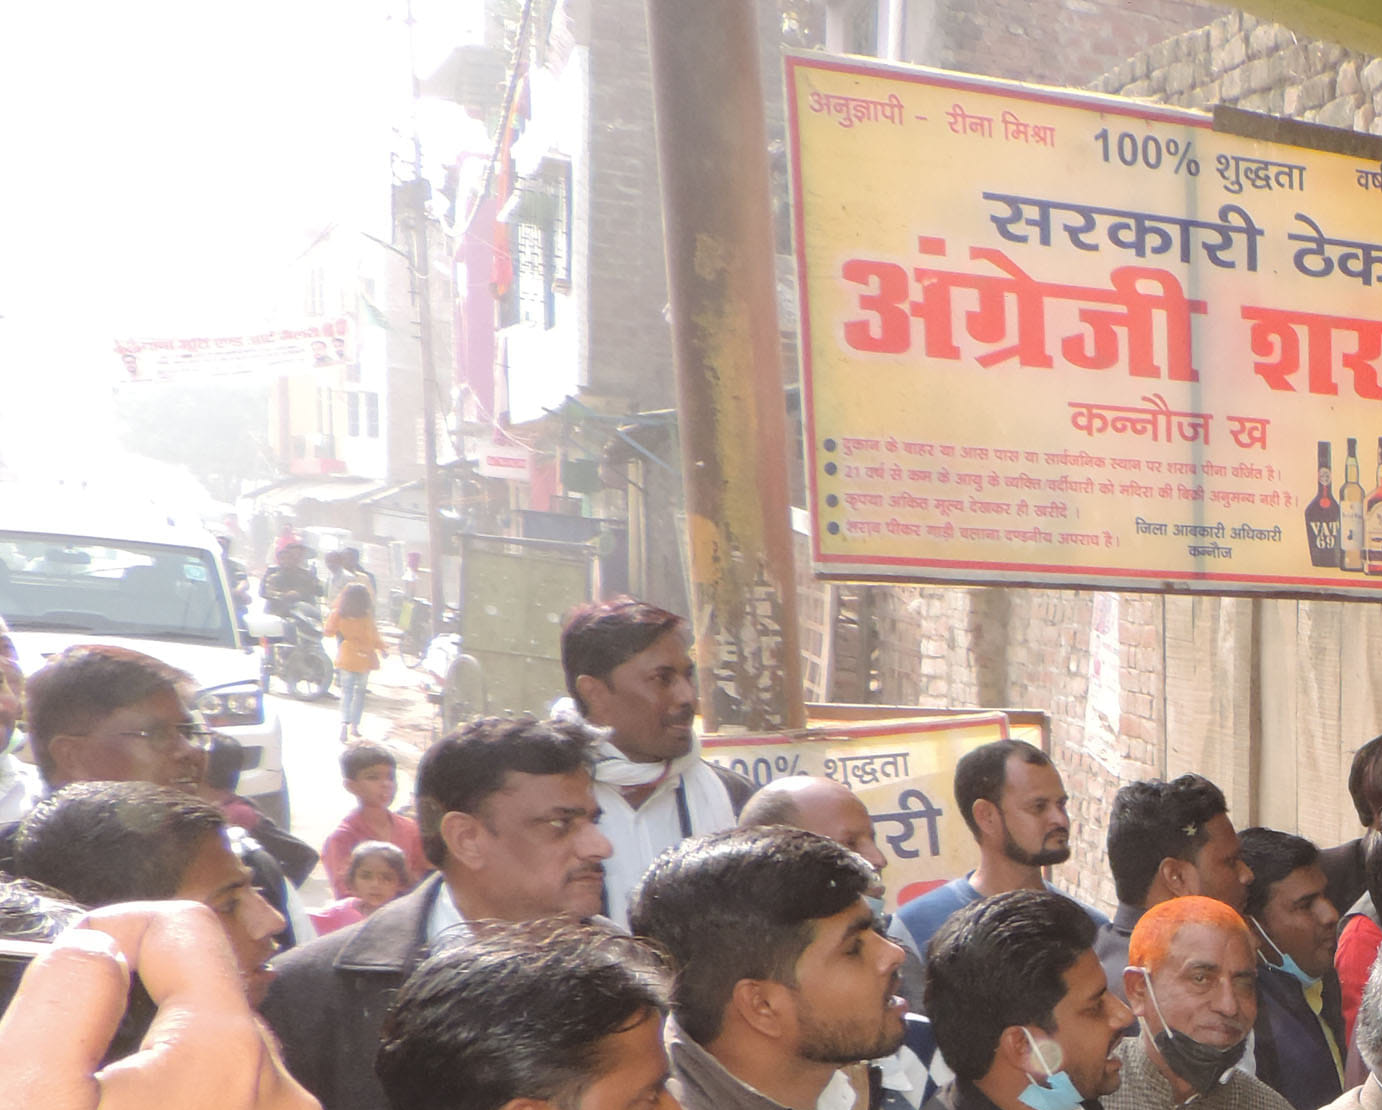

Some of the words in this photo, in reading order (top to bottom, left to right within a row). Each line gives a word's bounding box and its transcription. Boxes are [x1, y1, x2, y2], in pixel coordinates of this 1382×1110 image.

[809, 91, 904, 129] अनुज्ञापी
[945, 104, 994, 139] रीना
[1001, 111, 1056, 148] मिश्रा
[1094, 127, 1200, 177] 100%
[1215, 153, 1307, 194] शुद्धता
[982, 191, 1265, 272] सरकारी
[841, 235, 1208, 383] अंग्रेजी
[1068, 392, 1212, 447] कन्नौज
[1227, 414, 1271, 450] ख
[1147, 460, 1162, 473] पर
[1135, 516, 1168, 536] जिला
[1172, 521, 1226, 539] आबकारी
[1230, 525, 1282, 542] अधिकारी
[1310, 521, 1339, 537] VAT
[1316, 535, 1335, 549] 69
[1188, 542, 1233, 559] कन्नौज
[824, 752, 910, 788] शुद्धता
